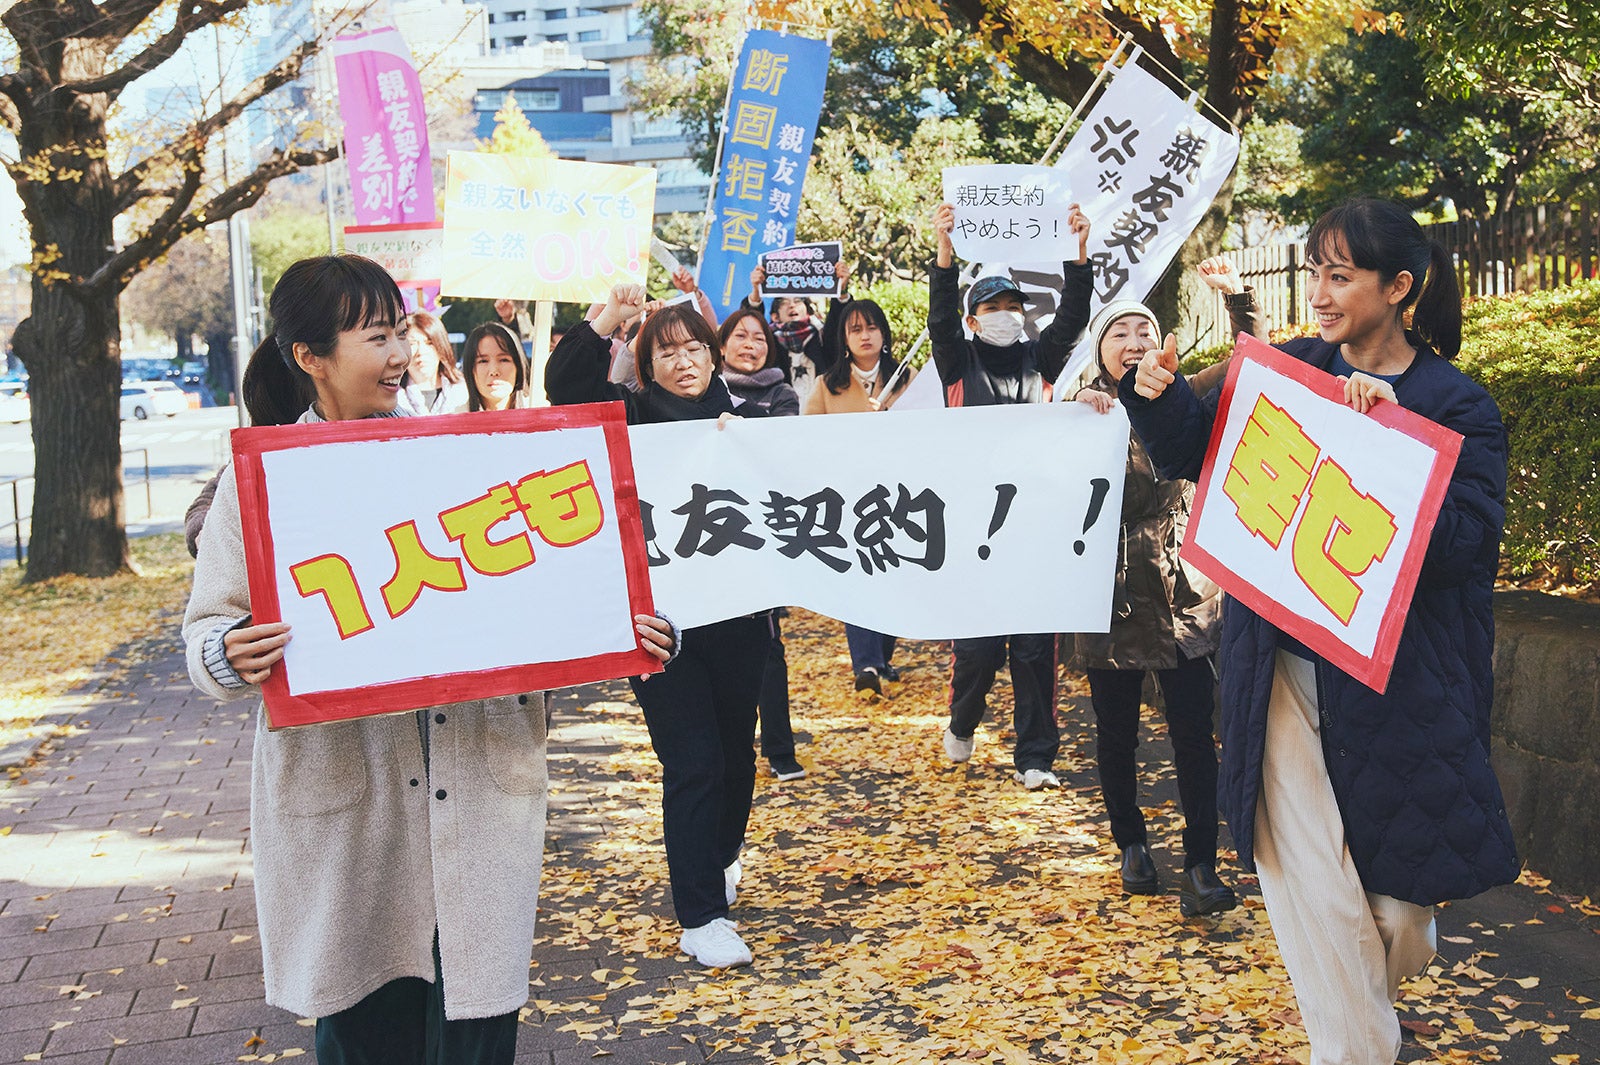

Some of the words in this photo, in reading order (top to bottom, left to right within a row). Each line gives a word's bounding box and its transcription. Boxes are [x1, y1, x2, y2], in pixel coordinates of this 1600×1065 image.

[357, 132, 393, 225] 差別
[376, 69, 420, 213] 親友契約で
[721, 48, 788, 306] 断固拒否！
[761, 123, 806, 248] 親友契約
[956, 184, 1044, 207] 親友契約
[463, 182, 636, 219] 親友いなくても
[957, 218, 1058, 240] やめよう！
[1091, 126, 1209, 304] 親友契約
[766, 260, 835, 274] 結ばなくても
[766, 275, 835, 289] 生きていける
[289, 459, 605, 640] 1人でも
[1222, 392, 1399, 627] 幸せ
